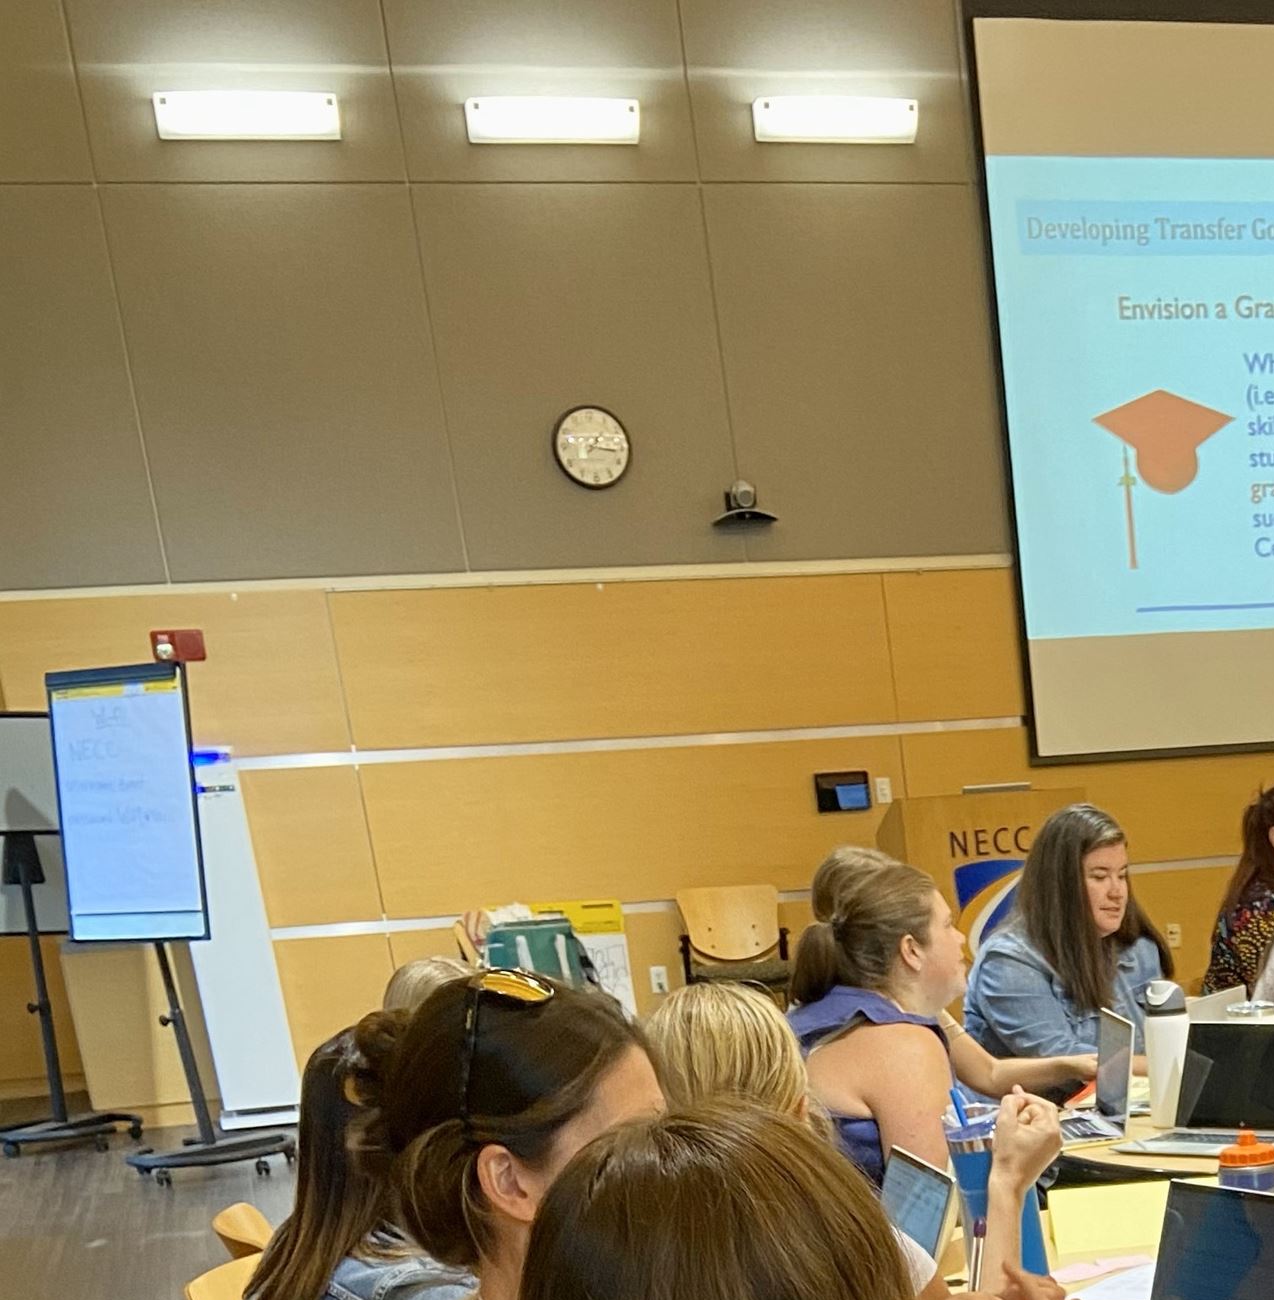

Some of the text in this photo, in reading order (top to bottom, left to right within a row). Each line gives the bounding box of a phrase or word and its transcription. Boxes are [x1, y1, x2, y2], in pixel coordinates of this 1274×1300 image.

[1026, 216, 1149, 247] Developing
[1154, 217, 1247, 240] Transfer
[1118, 296, 1208, 320] Envision
[1215, 301, 1227, 319] a
[950, 826, 1030, 858] NECC
